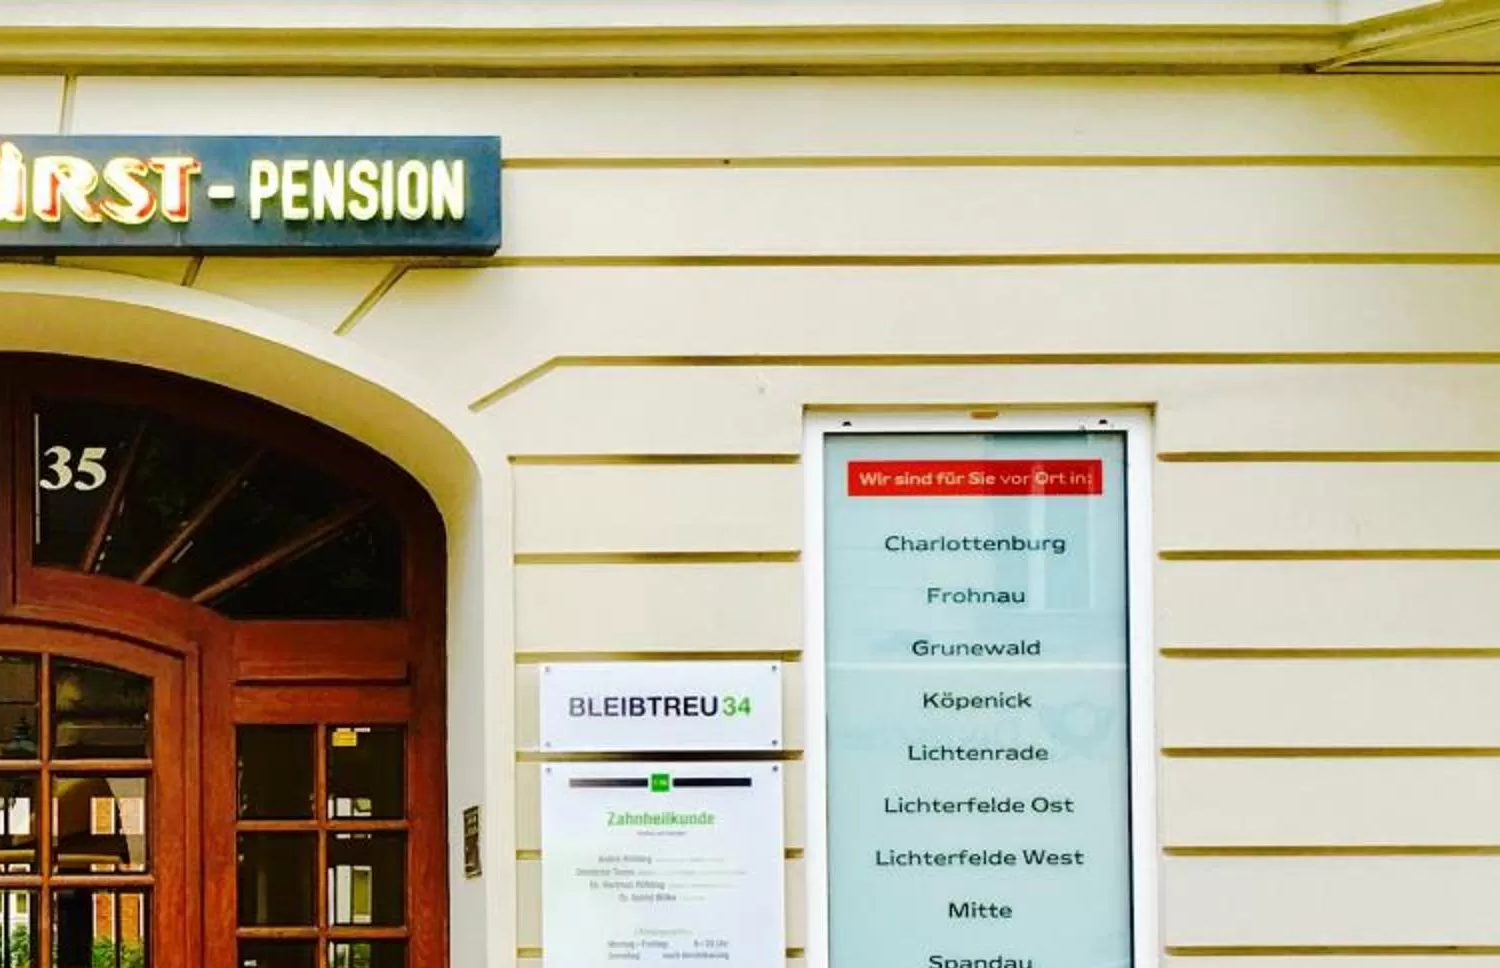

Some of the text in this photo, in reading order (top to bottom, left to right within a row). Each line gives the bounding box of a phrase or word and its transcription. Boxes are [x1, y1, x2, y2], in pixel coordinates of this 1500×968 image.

[248, 158, 466, 222] PENSION
[38, 445, 108, 492] 35
[859, 471, 891, 486] Wir
[894, 471, 933, 486] sind
[936, 470, 965, 486] für
[968, 470, 996, 486] Sie
[1000, 474, 1029, 485] vor
[1033, 471, 1066, 486] Ort
[884, 535, 1066, 555] Charlottenburg
[927, 587, 1026, 605] Frohnau
[911, 639, 1041, 657] Grunewald
[568, 696, 752, 717] BLEIBTREU34
[922, 691, 1032, 711] Köpenick
[907, 744, 1049, 762] Lichtenrade
[883, 796, 1075, 814] Lichterfelde Ost
[606, 811, 716, 826] Zahnheilkunde
[875, 849, 1085, 867] Lichterfelde West
[948, 901, 1013, 919] Mitte
